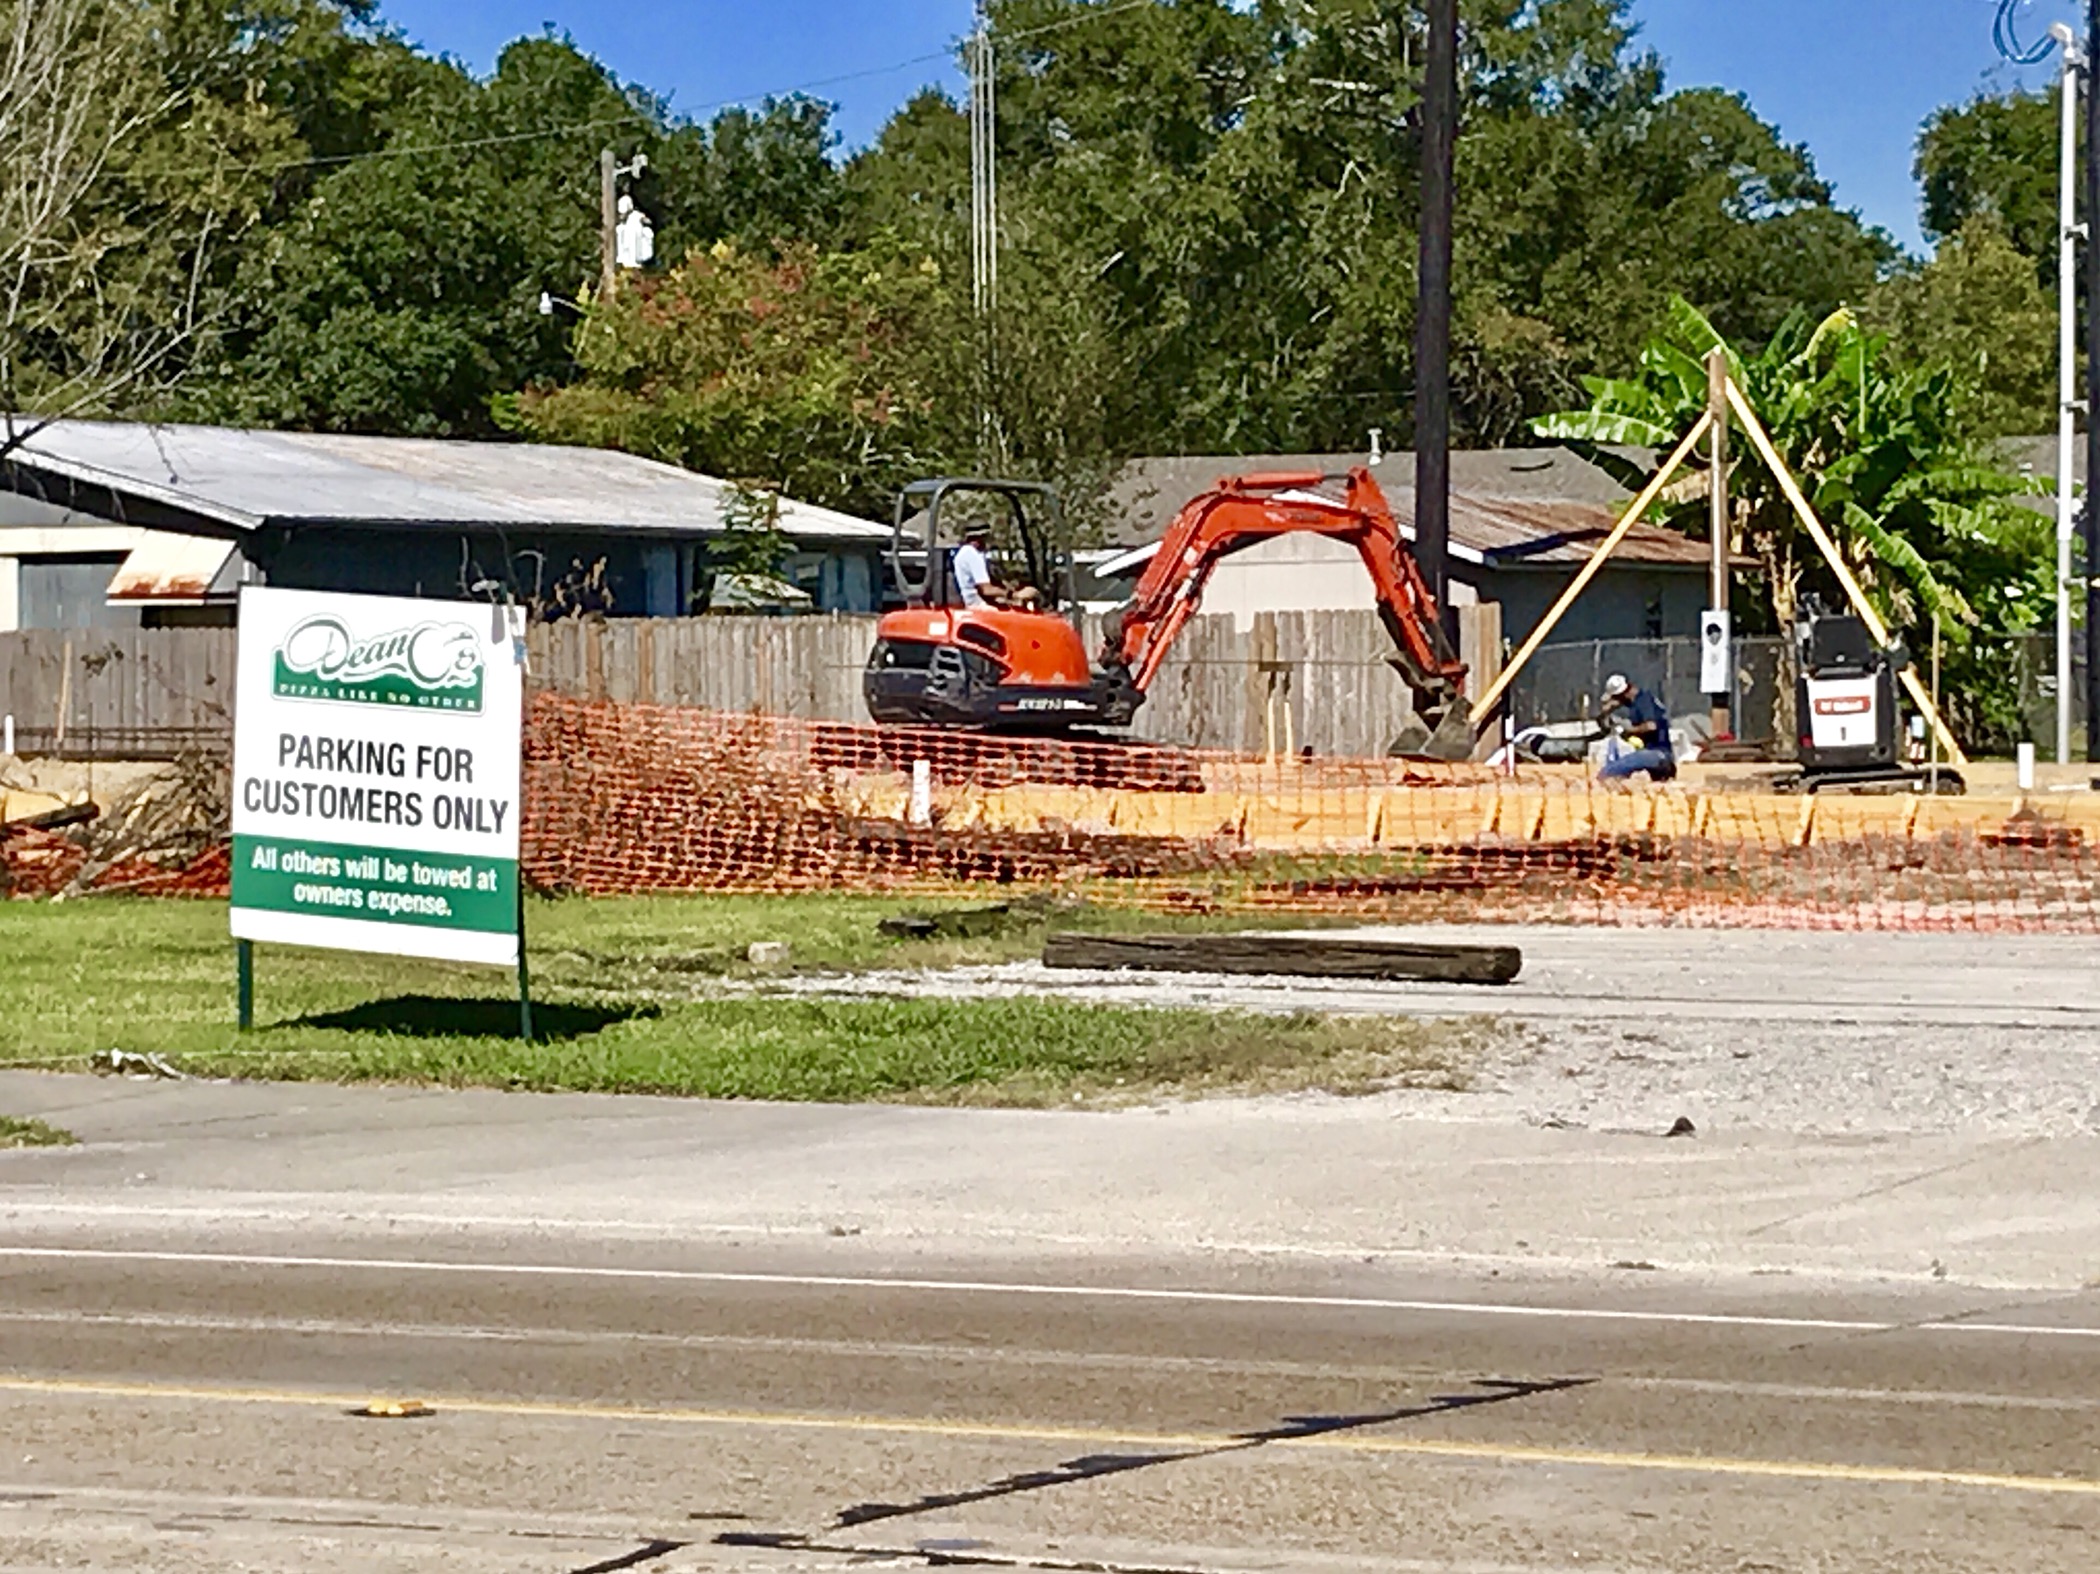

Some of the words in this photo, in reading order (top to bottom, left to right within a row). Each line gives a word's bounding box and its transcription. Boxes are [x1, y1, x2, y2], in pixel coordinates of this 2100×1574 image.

[279, 733, 405, 778] PARKING
[416, 745, 474, 783] FOR
[243, 777, 423, 827] CUSTOMERS
[433, 794, 509, 834] ONLY
[251, 846, 277, 870] All
[281, 850, 341, 878] others
[345, 855, 380, 880] will
[384, 857, 408, 883] be
[412, 861, 472, 889] towed
[476, 868, 498, 892] at
[293, 883, 363, 908] owners
[367, 890, 452, 916] expense.
